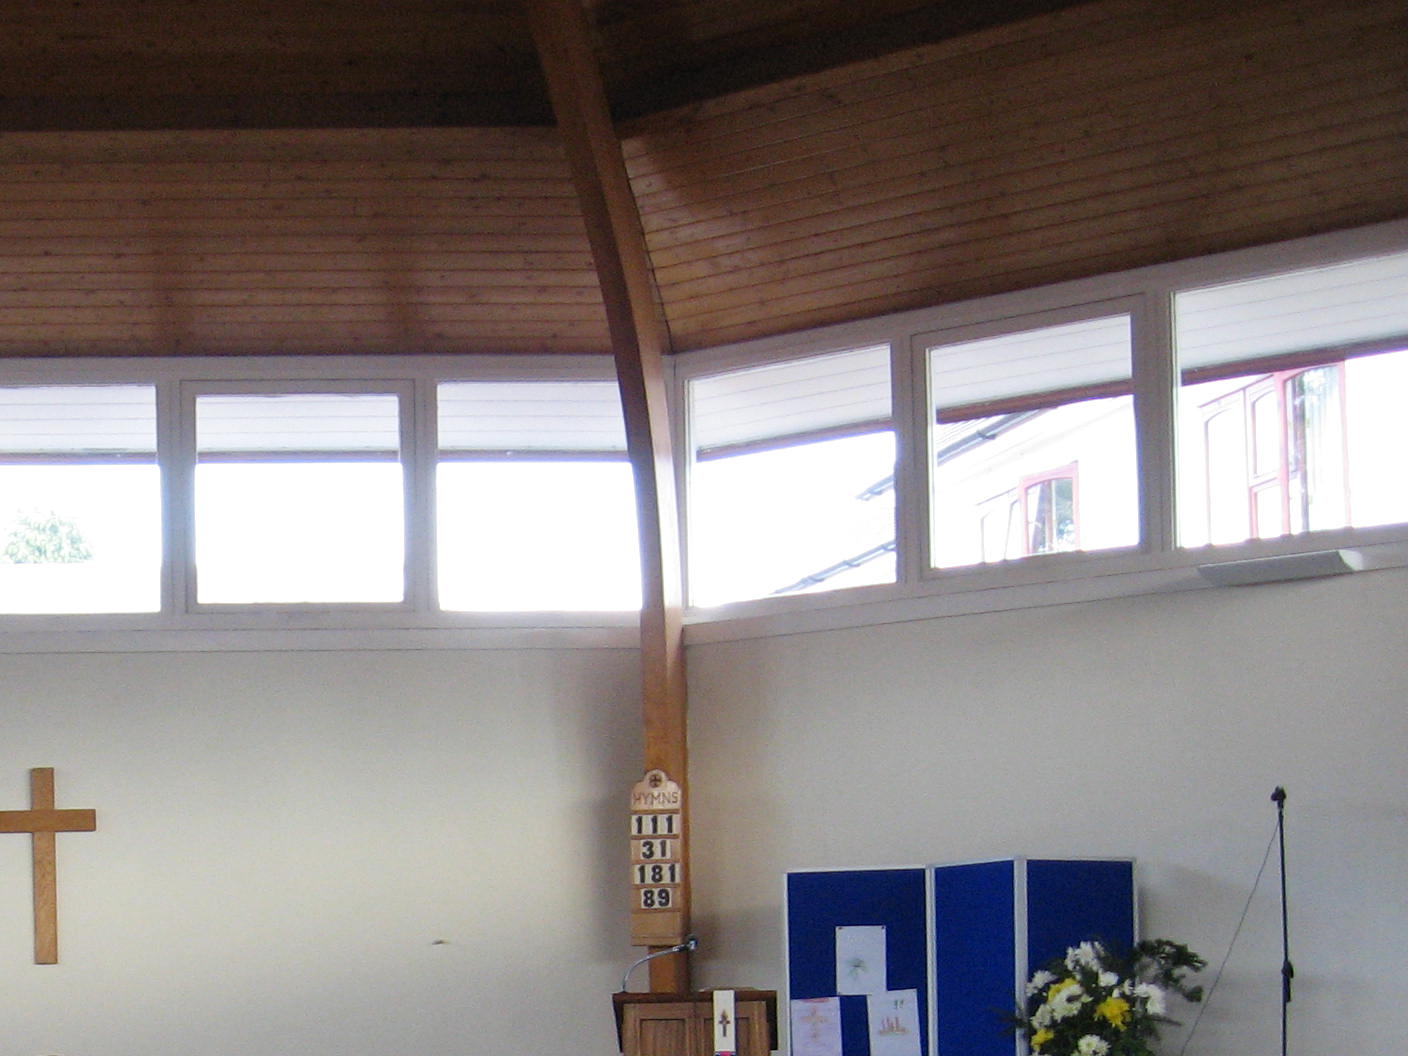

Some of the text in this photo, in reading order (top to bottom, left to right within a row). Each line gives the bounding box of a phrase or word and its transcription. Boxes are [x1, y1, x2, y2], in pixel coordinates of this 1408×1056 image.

[633, 792, 679, 805] HYMNS
[636, 815, 674, 834] 111
[642, 840, 667, 859] 31
[638, 864, 676, 883] 181
[643, 889, 670, 908] 89
